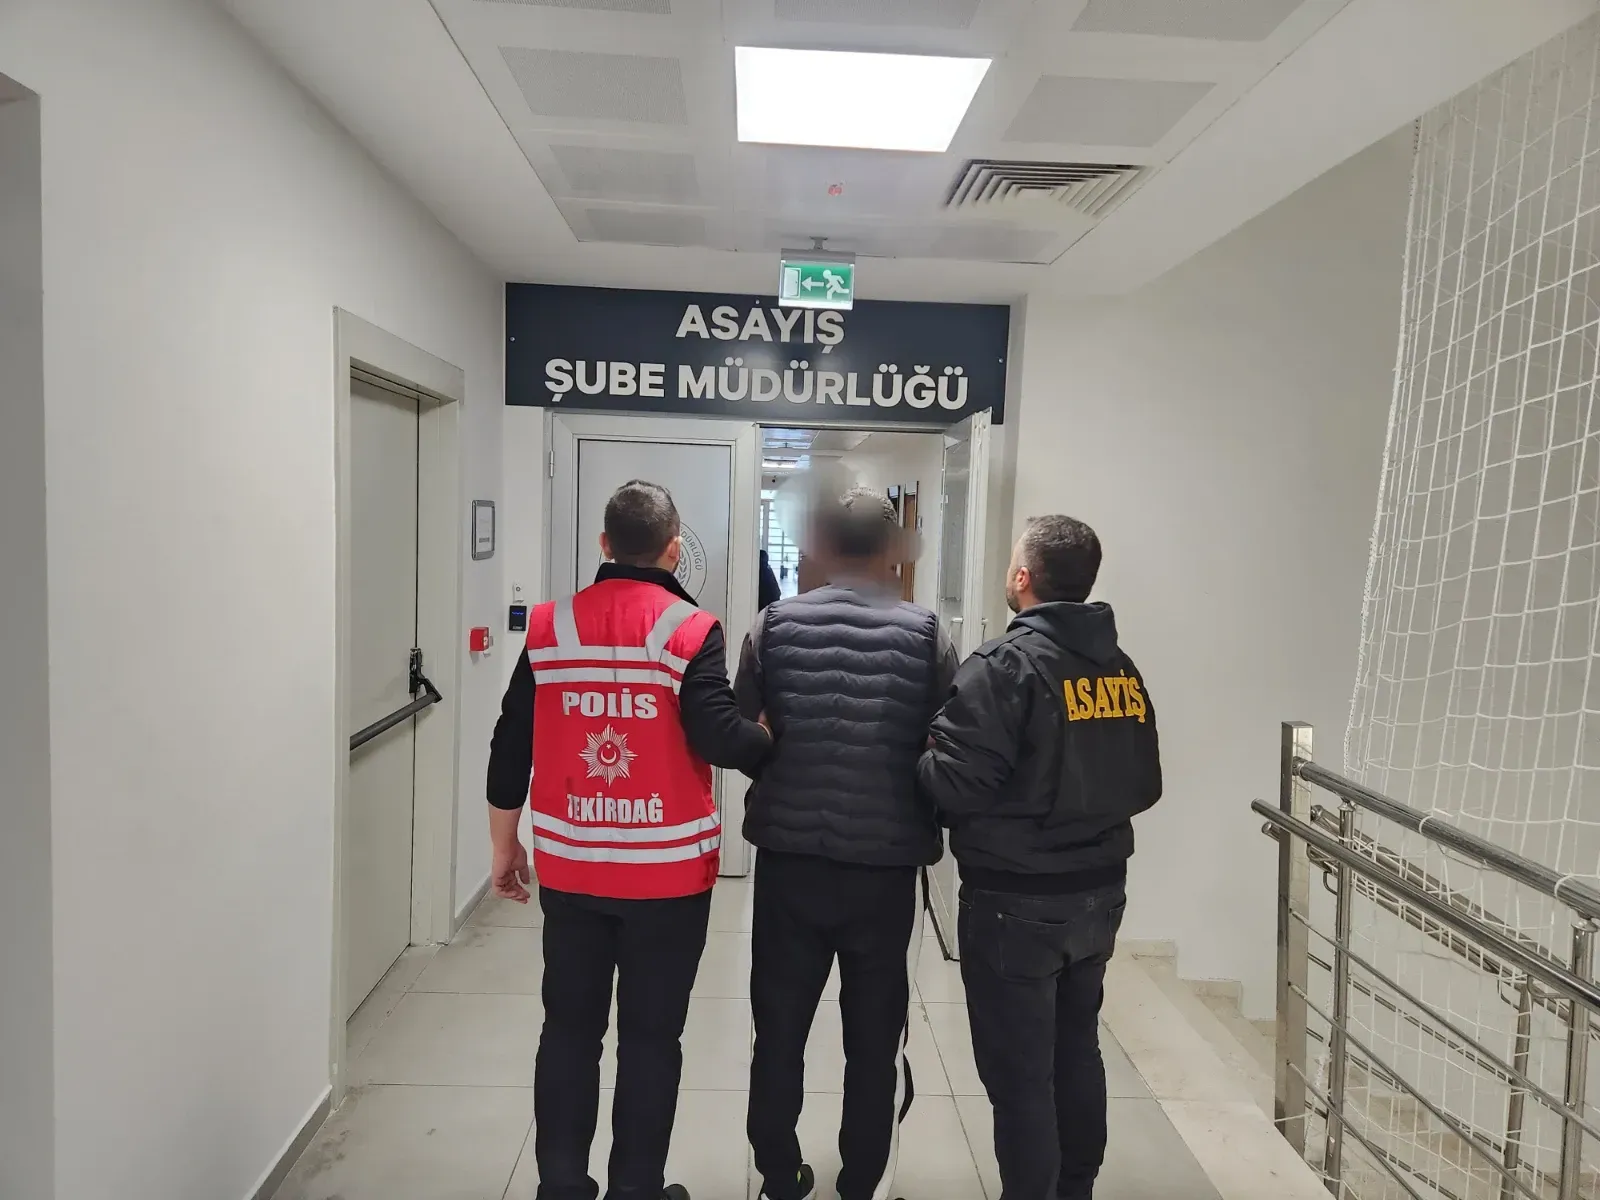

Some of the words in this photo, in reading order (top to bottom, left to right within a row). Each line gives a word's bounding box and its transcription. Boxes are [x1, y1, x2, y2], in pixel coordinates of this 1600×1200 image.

[544, 358, 666, 402] ŞUBE
[678, 356, 969, 410] MÜDÜRLÜĞÜ
[562, 687, 659, 719] POLİS
[1063, 668, 1147, 723] ASAYİŞ
[566, 791, 664, 824] TEKİRDAĞ
